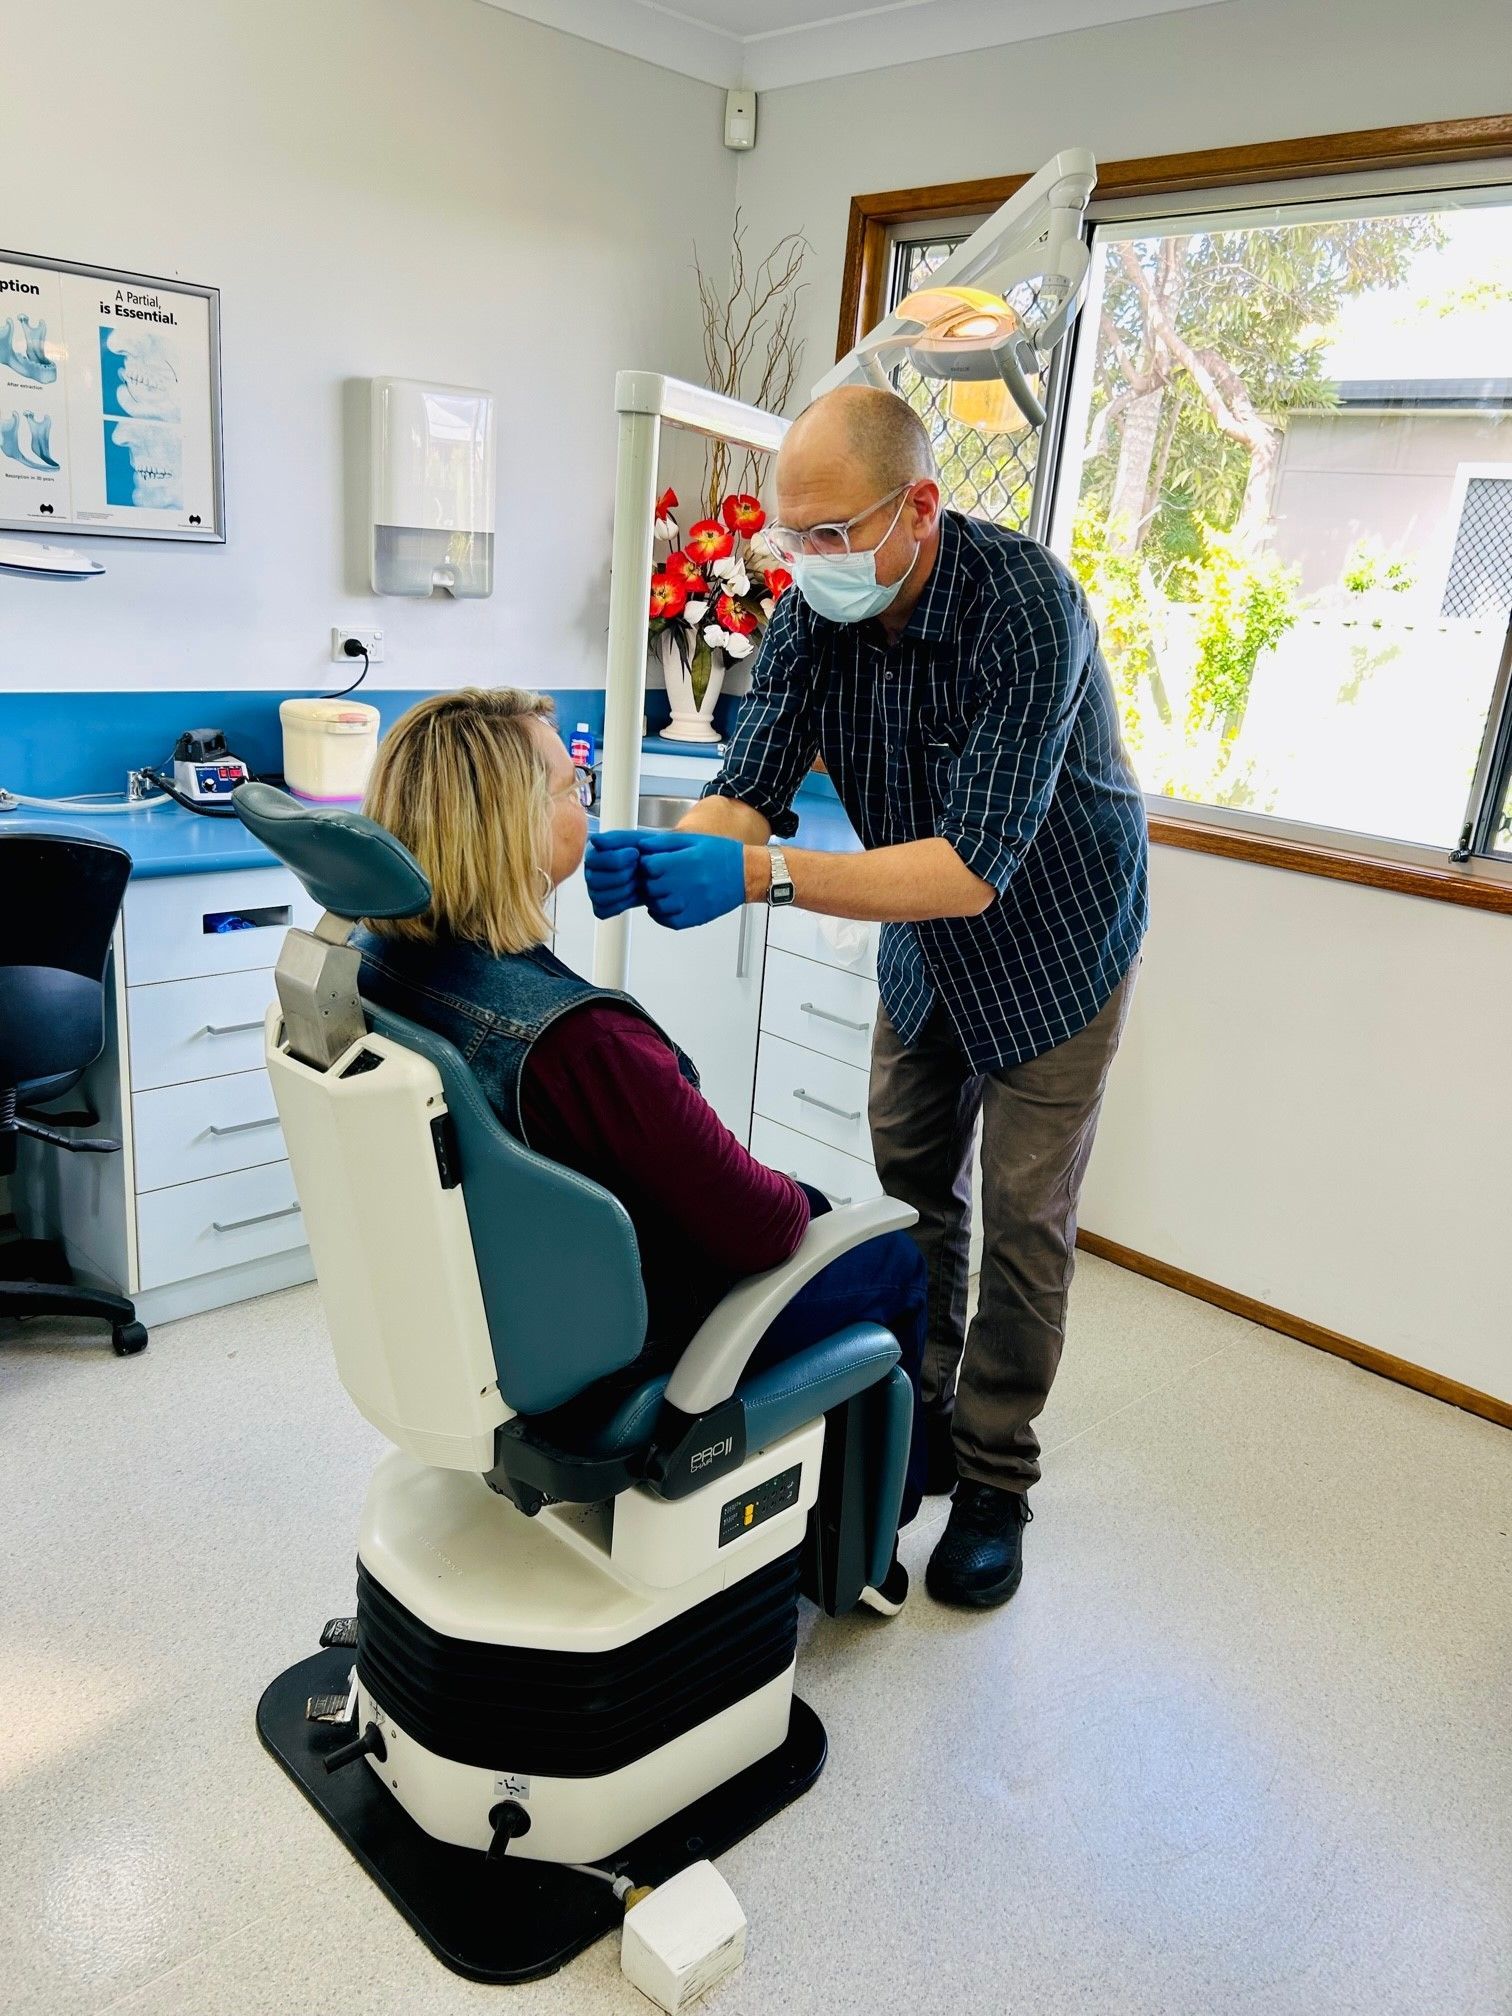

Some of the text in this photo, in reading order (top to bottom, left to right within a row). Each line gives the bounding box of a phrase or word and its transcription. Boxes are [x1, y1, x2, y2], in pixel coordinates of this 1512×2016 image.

[0, 279, 40, 295] ption
[115, 290, 161, 309] A Partial,
[100, 301, 178, 325] is Essential.
